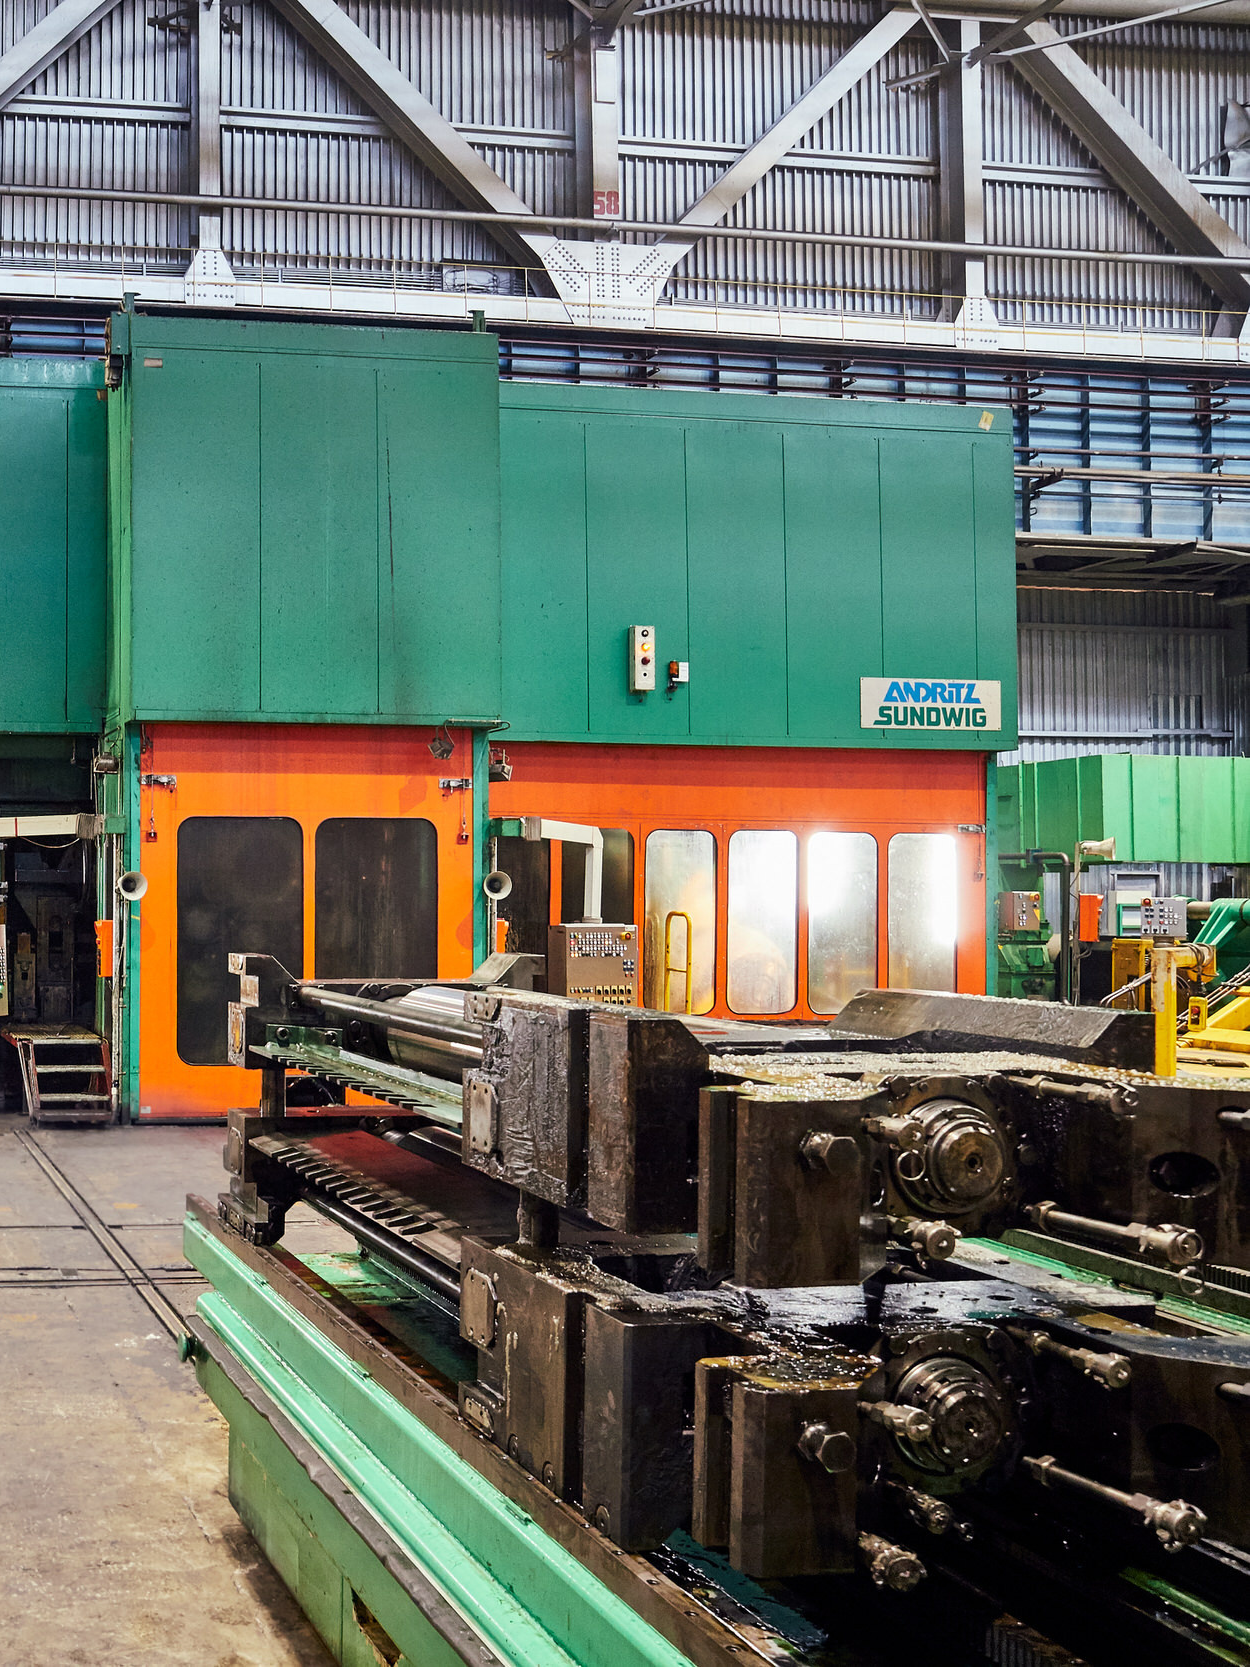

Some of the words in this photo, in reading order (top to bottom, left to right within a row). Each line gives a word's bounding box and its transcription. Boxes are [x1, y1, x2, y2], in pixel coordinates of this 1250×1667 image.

[593, 190, 620, 215] 58
[883, 681, 982, 704] ANDRITZ
[873, 705, 987, 727] SUNDWIG
